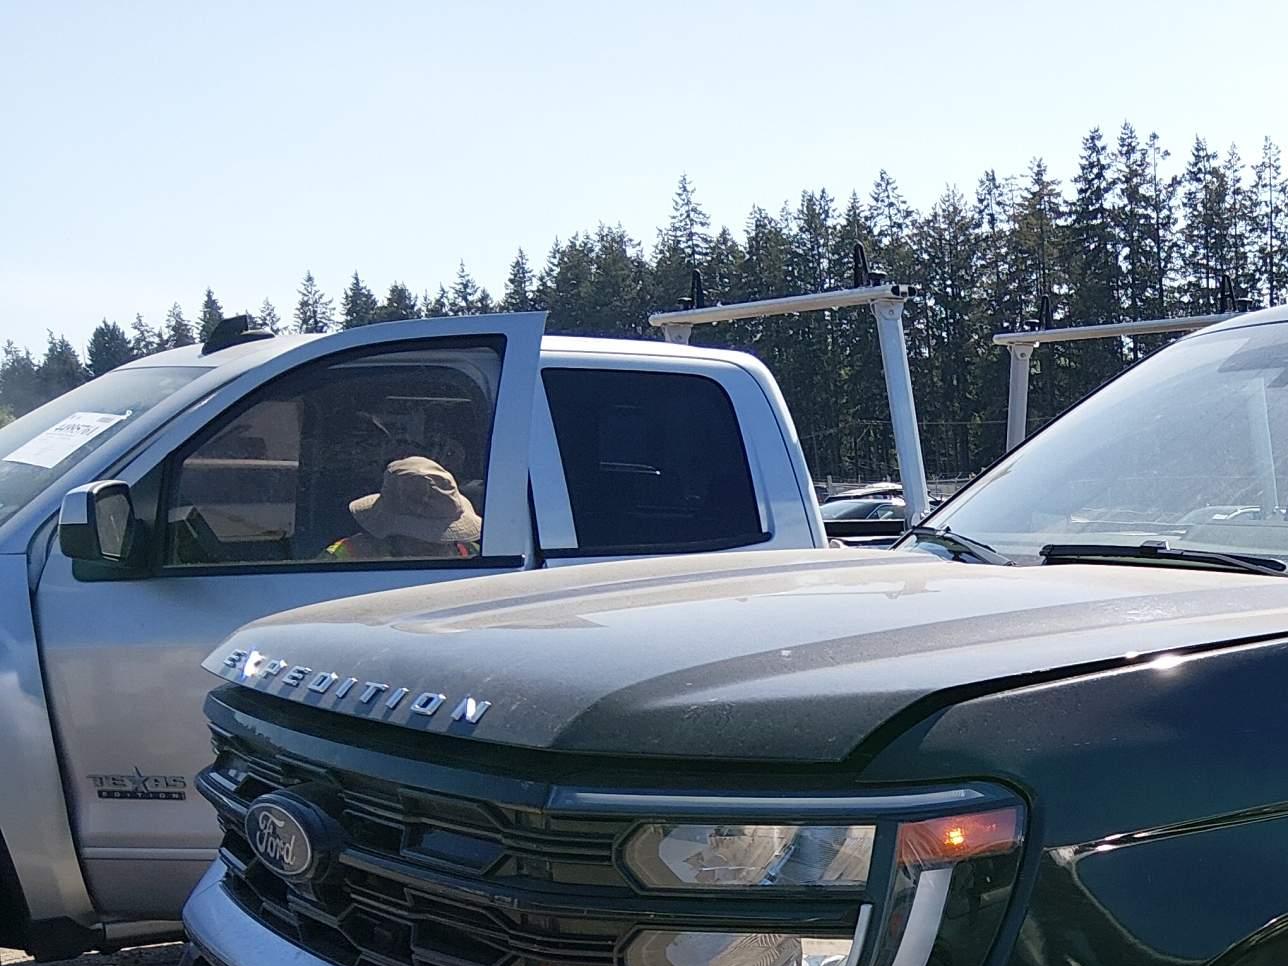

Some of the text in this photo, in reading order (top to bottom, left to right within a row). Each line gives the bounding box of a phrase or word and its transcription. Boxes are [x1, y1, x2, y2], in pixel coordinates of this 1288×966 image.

[86, 768, 187, 790] TEXAS
[99, 791, 183, 800] EDITION
[256, 810, 297, 867] Ford
